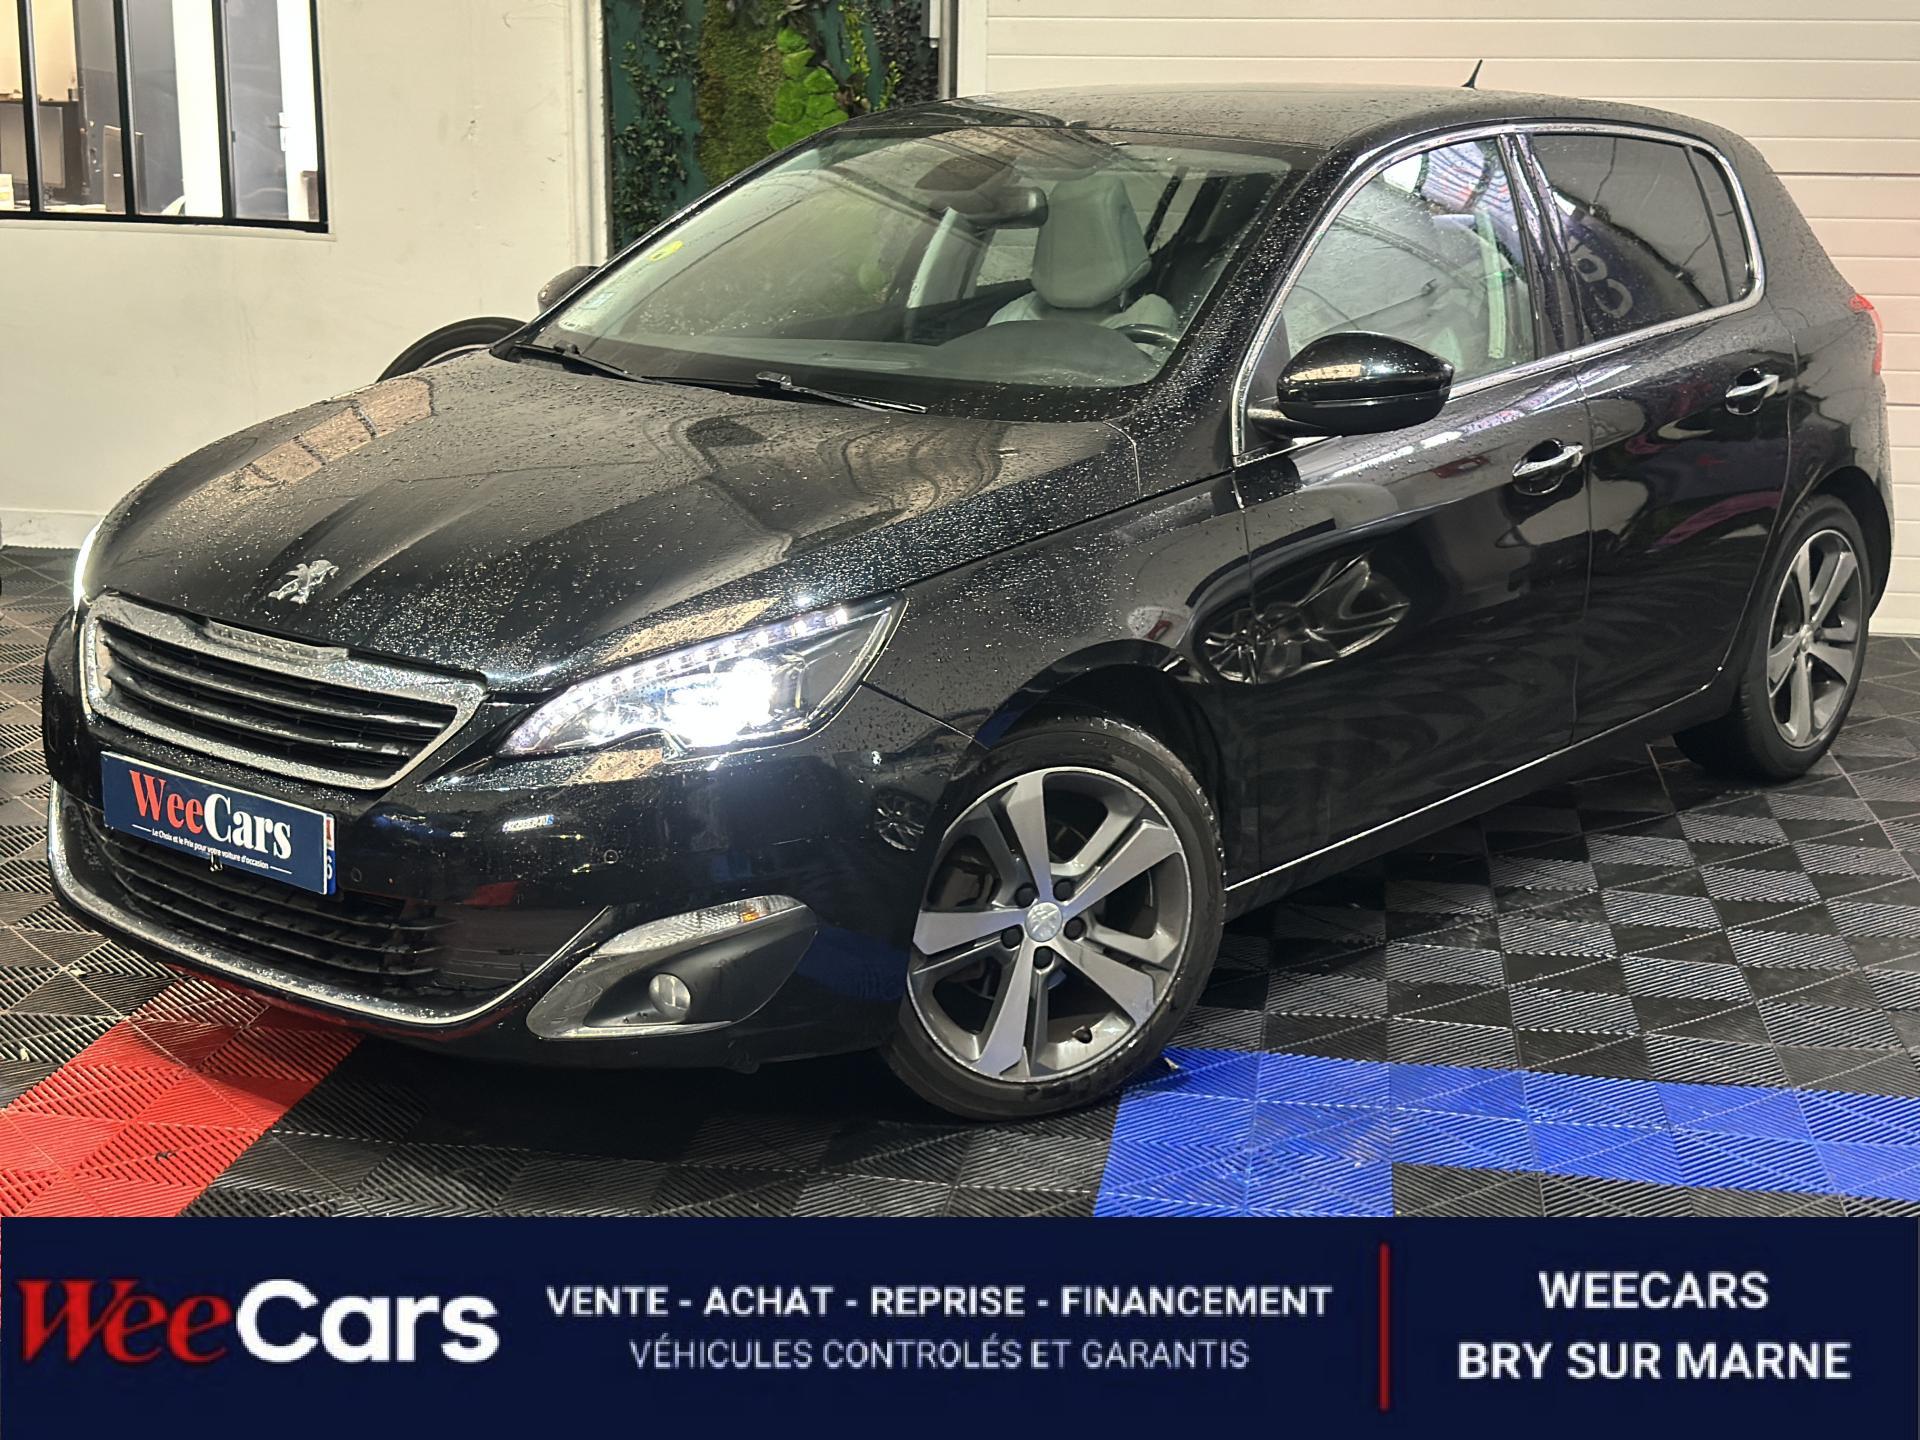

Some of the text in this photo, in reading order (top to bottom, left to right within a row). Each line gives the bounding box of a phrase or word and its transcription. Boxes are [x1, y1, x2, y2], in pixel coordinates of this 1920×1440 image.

[129, 769, 292, 860] WeeCars
[159, 830, 172, 841] Choix
[221, 850, 240, 862] voiture
